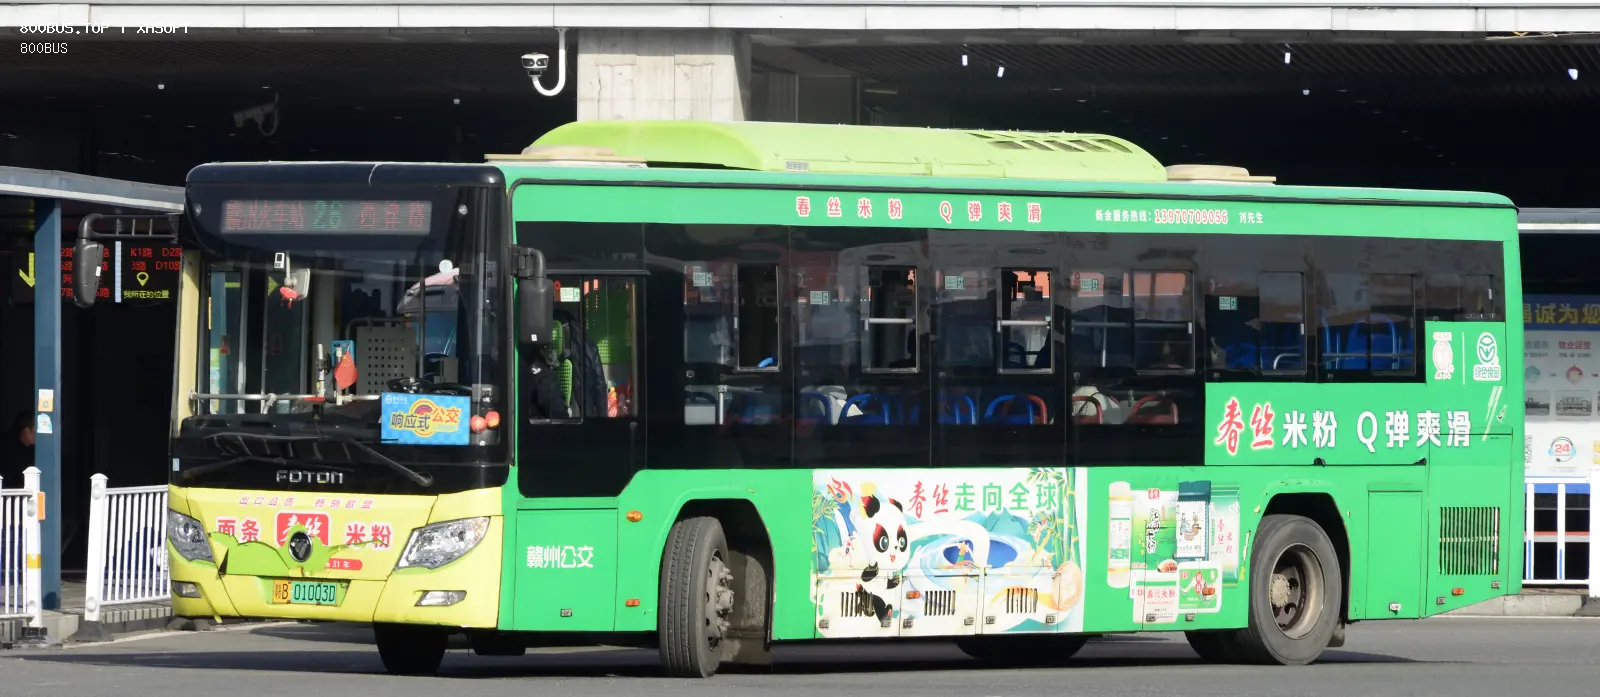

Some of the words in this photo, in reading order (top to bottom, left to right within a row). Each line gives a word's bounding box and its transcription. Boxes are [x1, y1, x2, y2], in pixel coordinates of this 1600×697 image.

[796, 197, 902, 218] 春丝米粉
[940, 202, 1041, 223] Q弹爽滑
[1154, 208, 1228, 224] 13970709056
[1239, 212, 1264, 224] 刘先生
[130, 247, 152, 257] K1路
[131, 261, 146, 270] 3路
[1356, 410, 1471, 452] Q弹爽滑
[1555, 443, 1570, 453] 24
[276, 470, 343, 484] FOTON
[239, 495, 296, 507] 出口品质
[345, 523, 392, 548] 米粉
[527, 545, 594, 569] 赣州公交
[294, 583, 336, 602] 01003D
